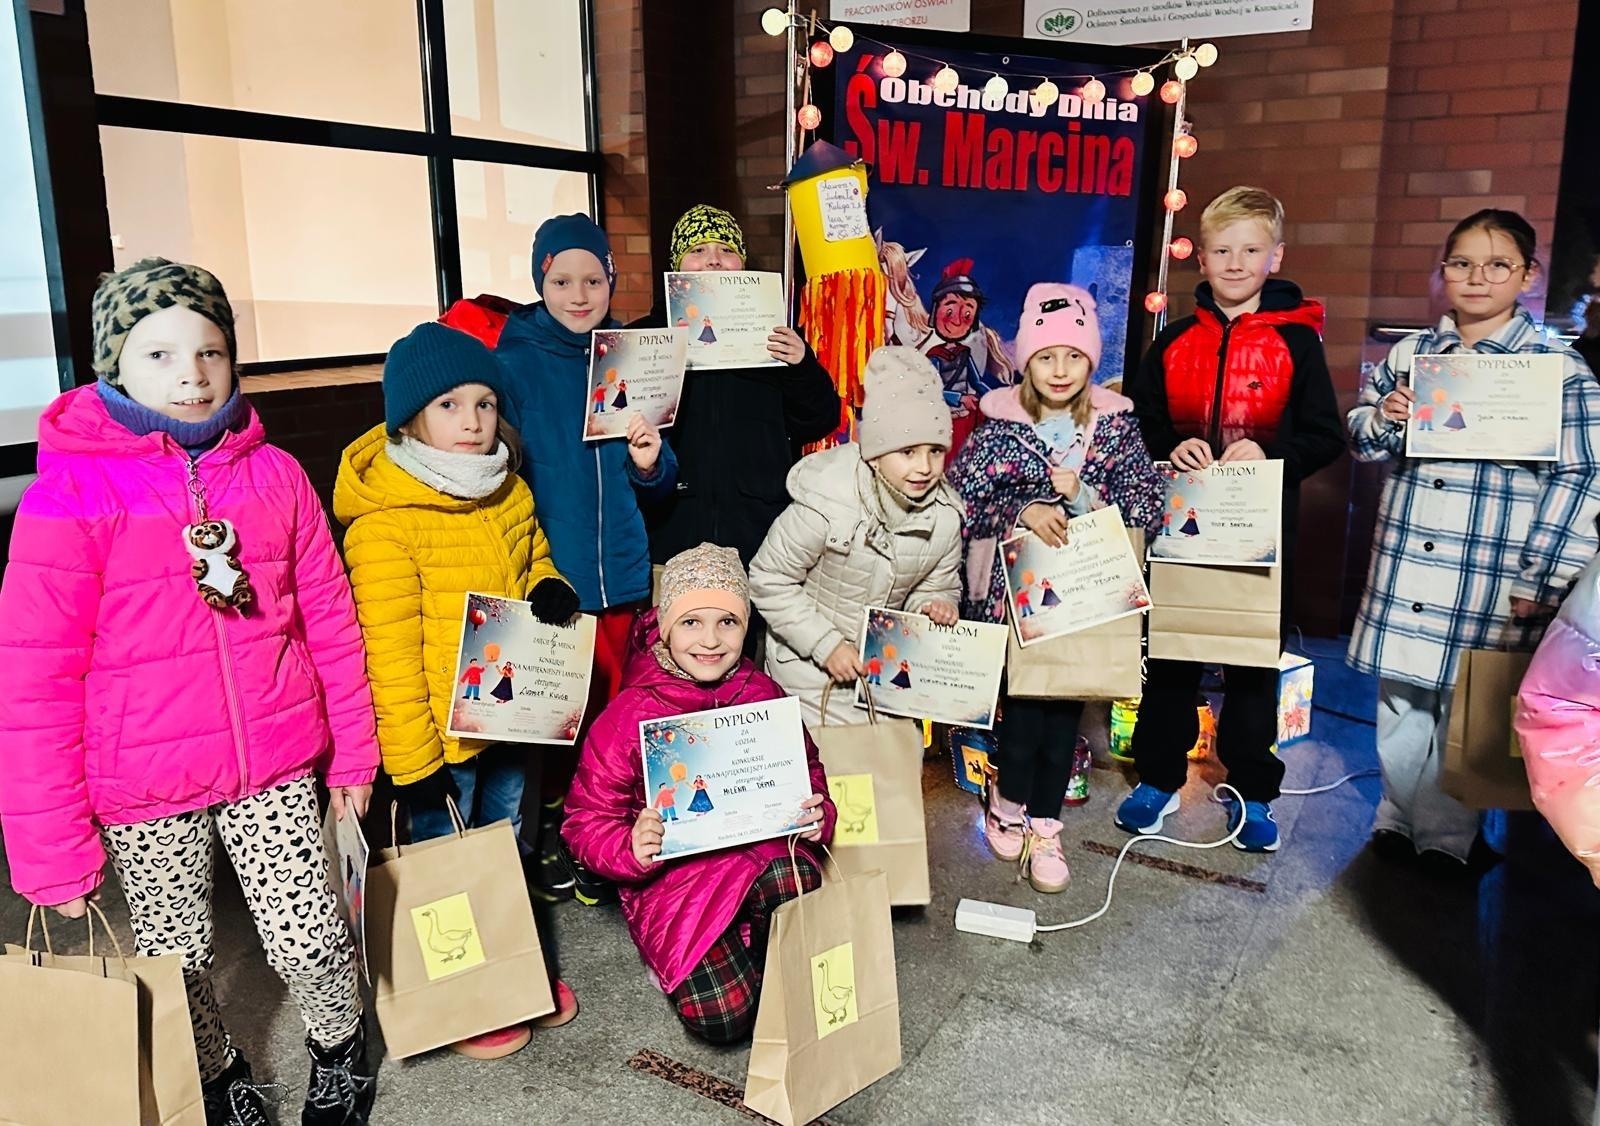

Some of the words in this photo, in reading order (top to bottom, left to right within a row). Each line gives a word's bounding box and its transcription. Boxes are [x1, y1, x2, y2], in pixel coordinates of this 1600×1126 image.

[844, 1, 913, 16] PRACOWNIKÓW
[879, 76, 1051, 118] Obchody
[1057, 93, 1139, 123] Dnia
[843, 54, 929, 186] Św.
[942, 110, 1136, 197] Marcina
[719, 275, 761, 287] DYPLOM
[639, 333, 674, 346] DYPLOM
[1477, 359, 1531, 370] DYPLOM
[1211, 466, 1257, 477] DYPLOM
[714, 709, 770, 730] DYPLOM
